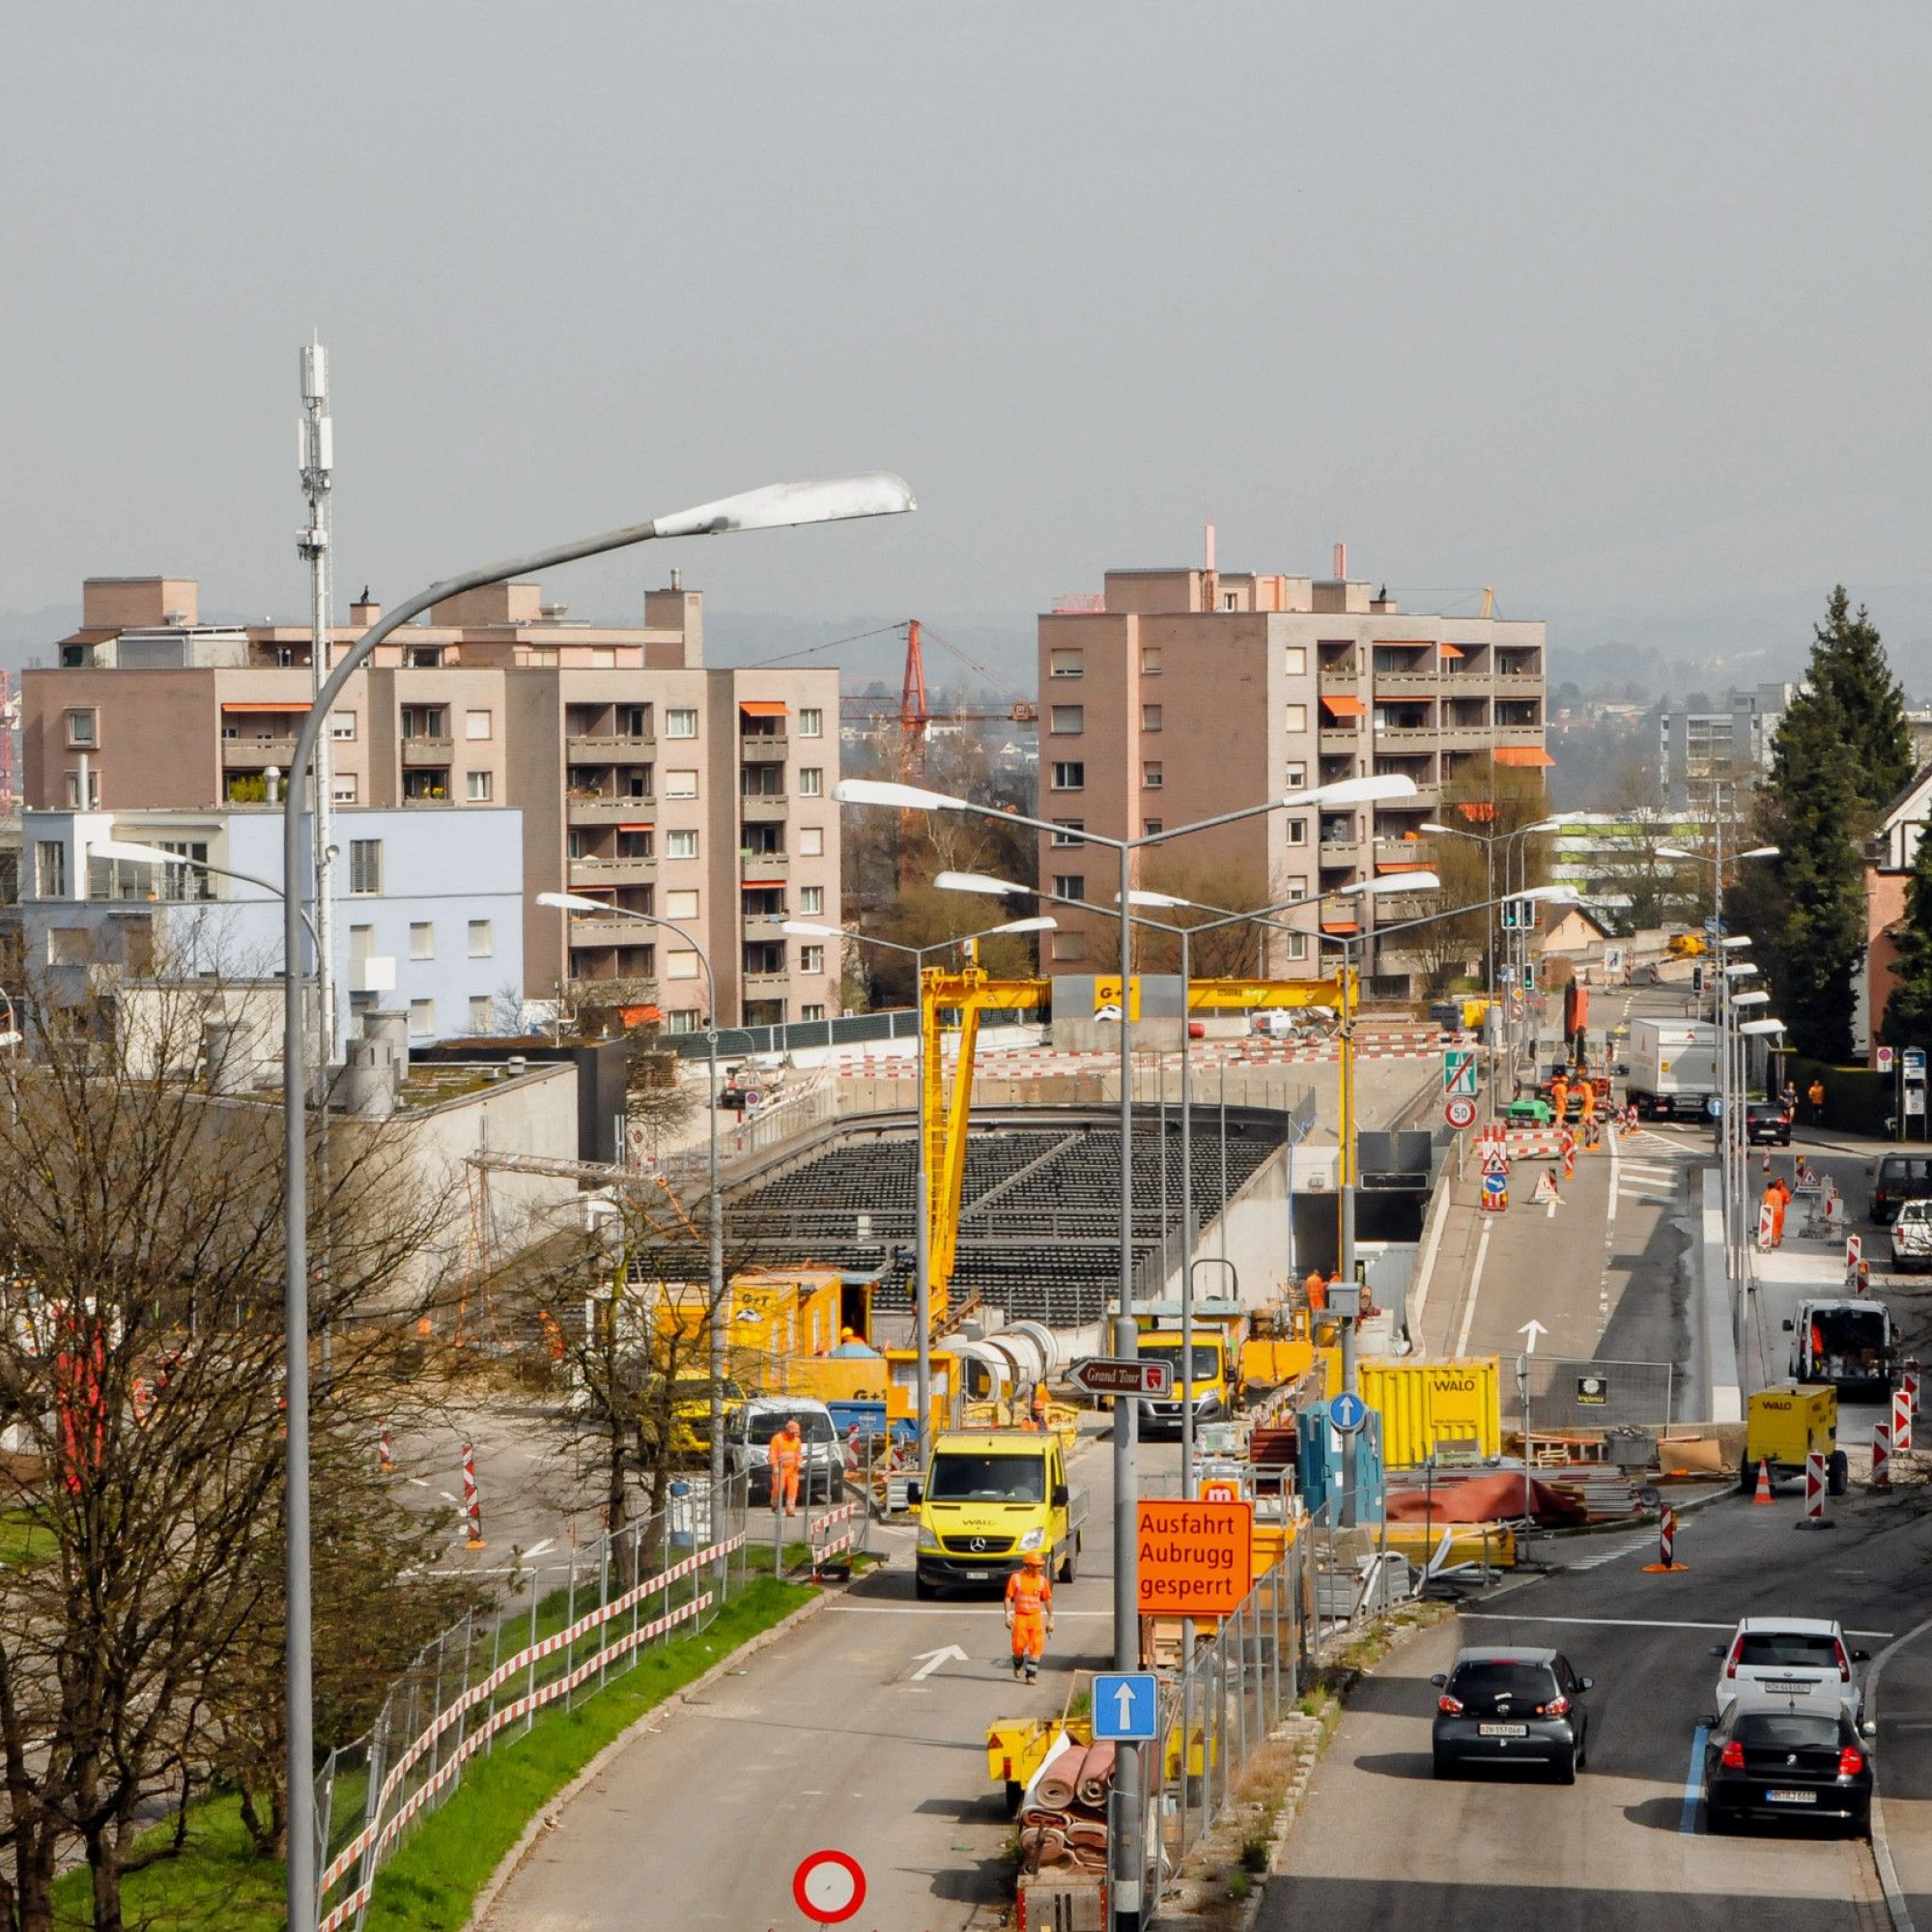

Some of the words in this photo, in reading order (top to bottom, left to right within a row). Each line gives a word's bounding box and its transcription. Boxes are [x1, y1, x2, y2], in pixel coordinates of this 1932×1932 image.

[1454, 1107, 1467, 1119] 50
[1087, 1367, 1116, 1382] Grand
[1119, 1370, 1140, 1383] Tour
[1435, 1379, 1475, 1391] WALO
[1762, 1402, 1792, 1410] WALO
[1140, 1513, 1234, 1534] Ausfahrt
[1140, 1542, 1234, 1569] Aubrugg
[1140, 1577, 1233, 1600] gesperrt
